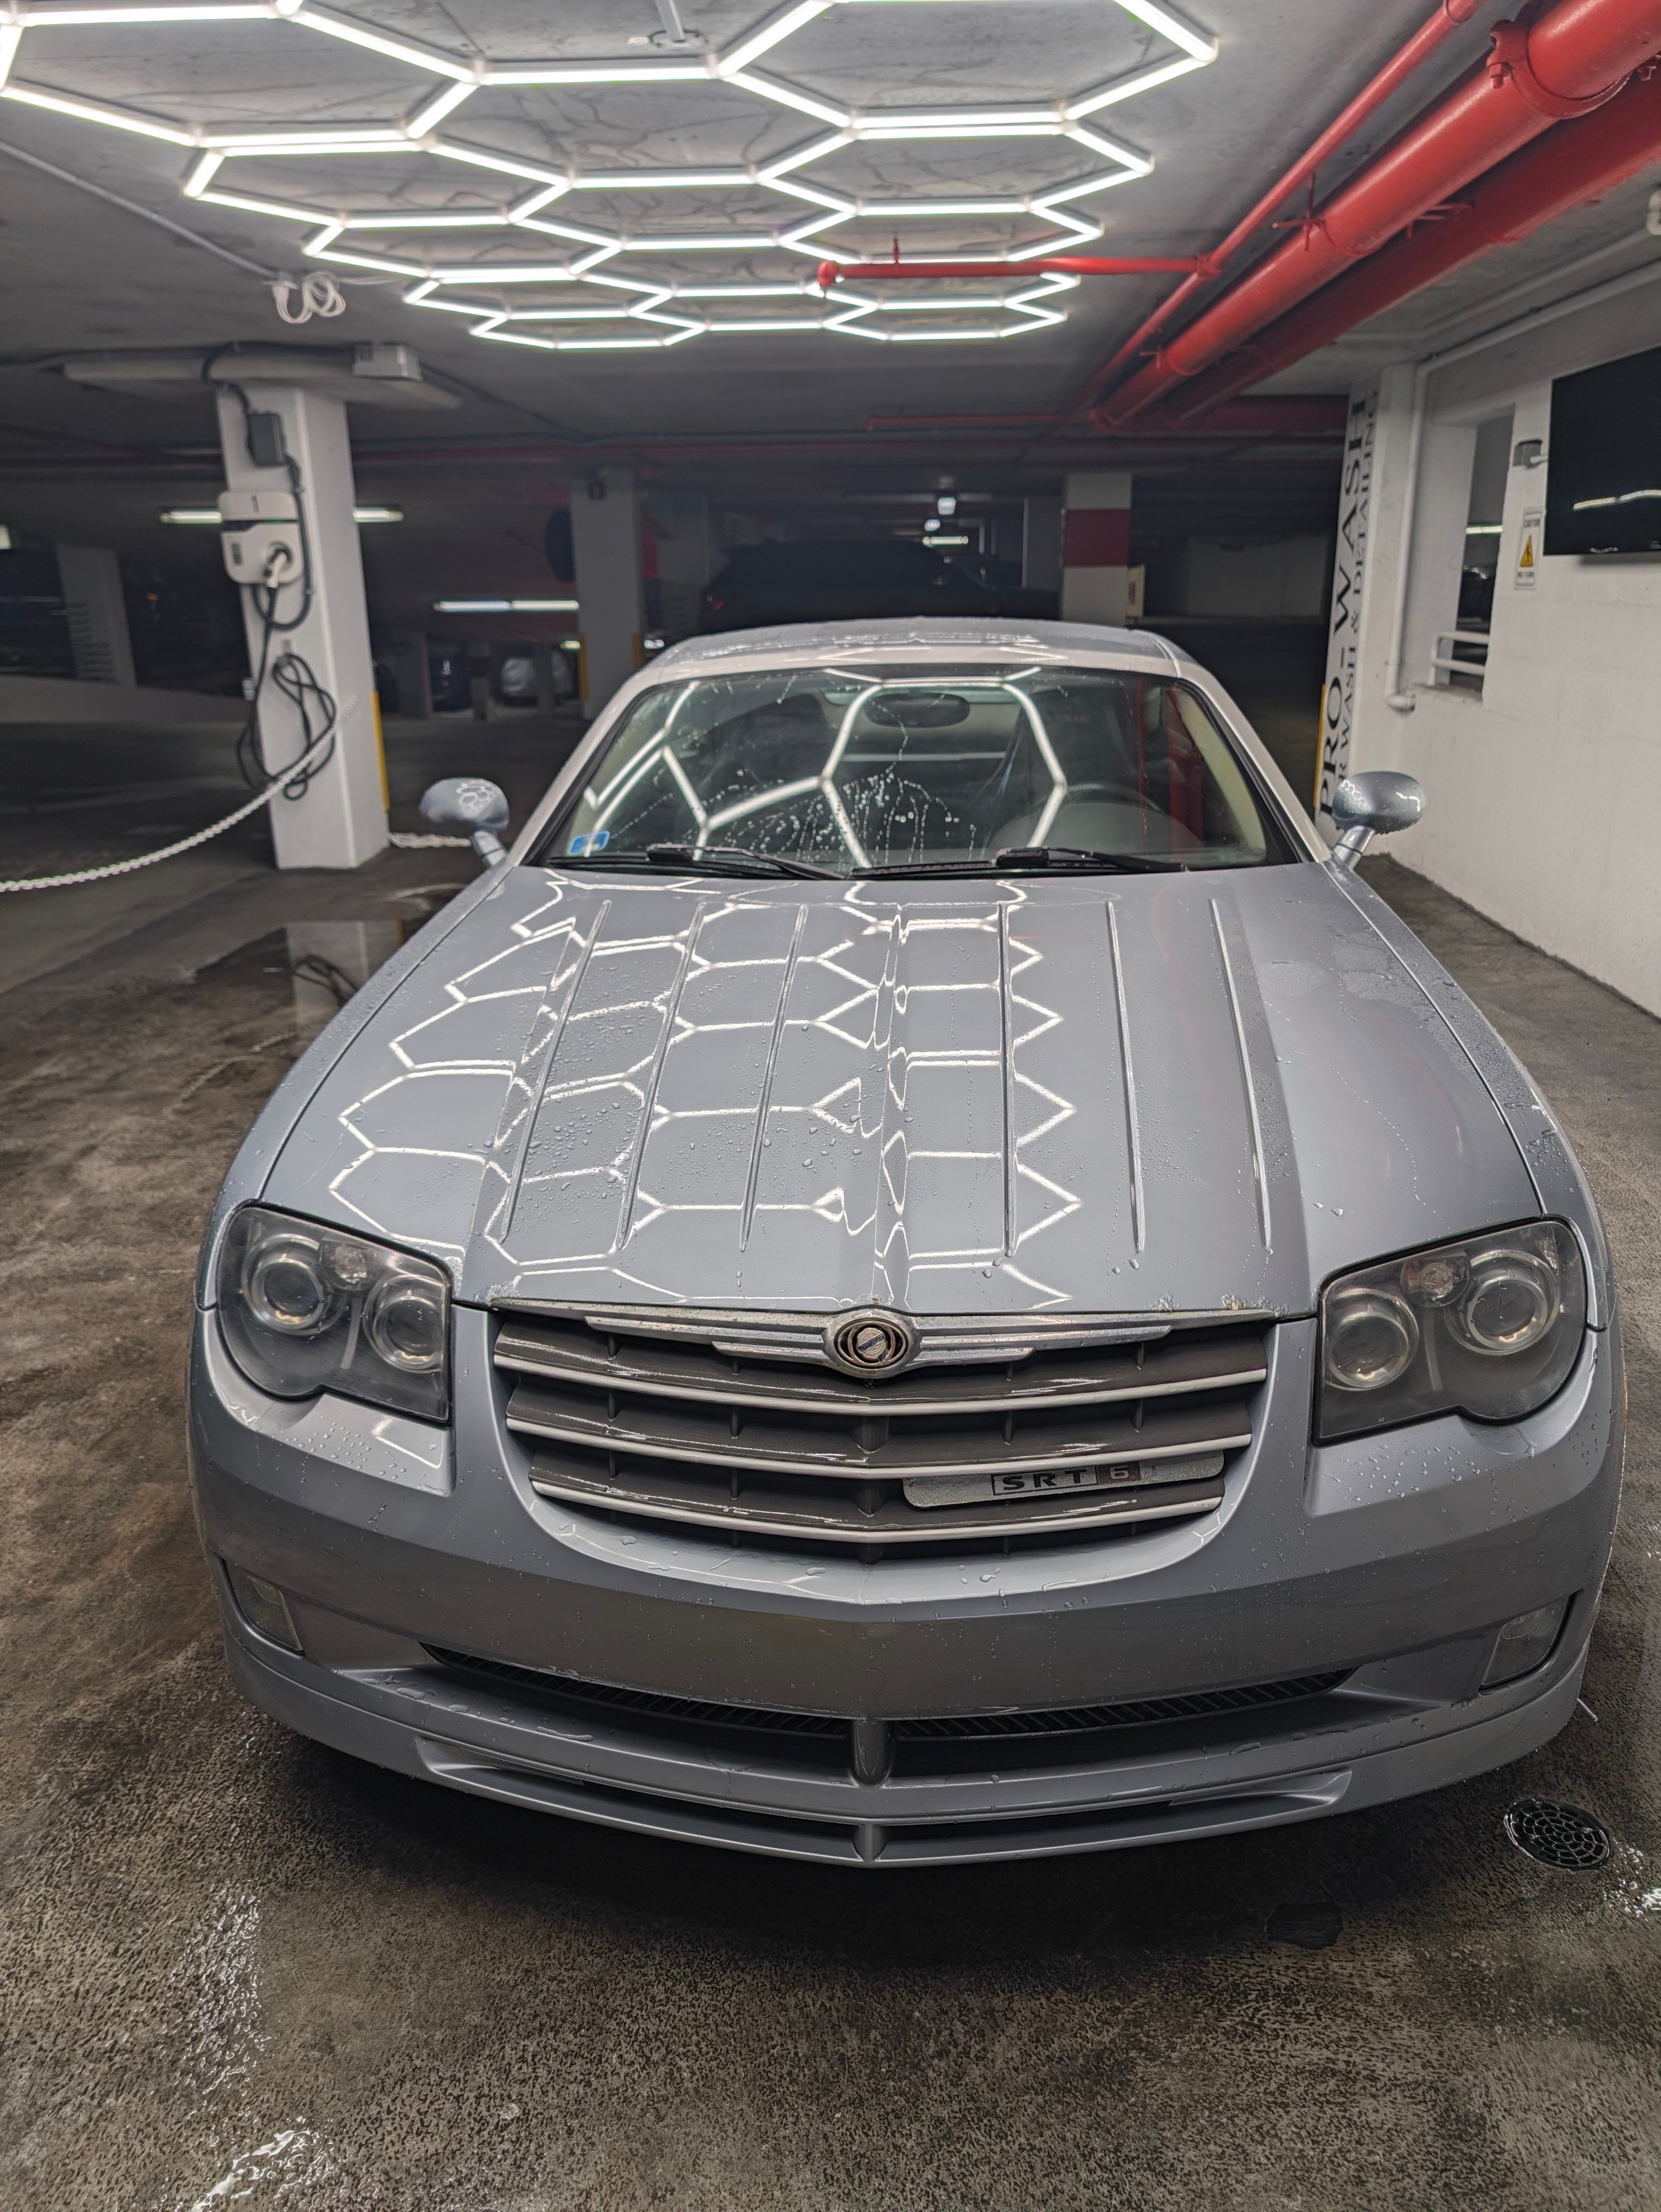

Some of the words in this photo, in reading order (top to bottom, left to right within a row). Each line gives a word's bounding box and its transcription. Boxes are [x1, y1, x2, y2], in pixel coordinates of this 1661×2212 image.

[1353, 389, 1379, 595] DETAILING
[1350, 608, 1359, 634] &
[1340, 646, 1356, 749] WASH
[1003, 1469, 1086, 1490] SRT
[1110, 1465, 1129, 1480] 6
